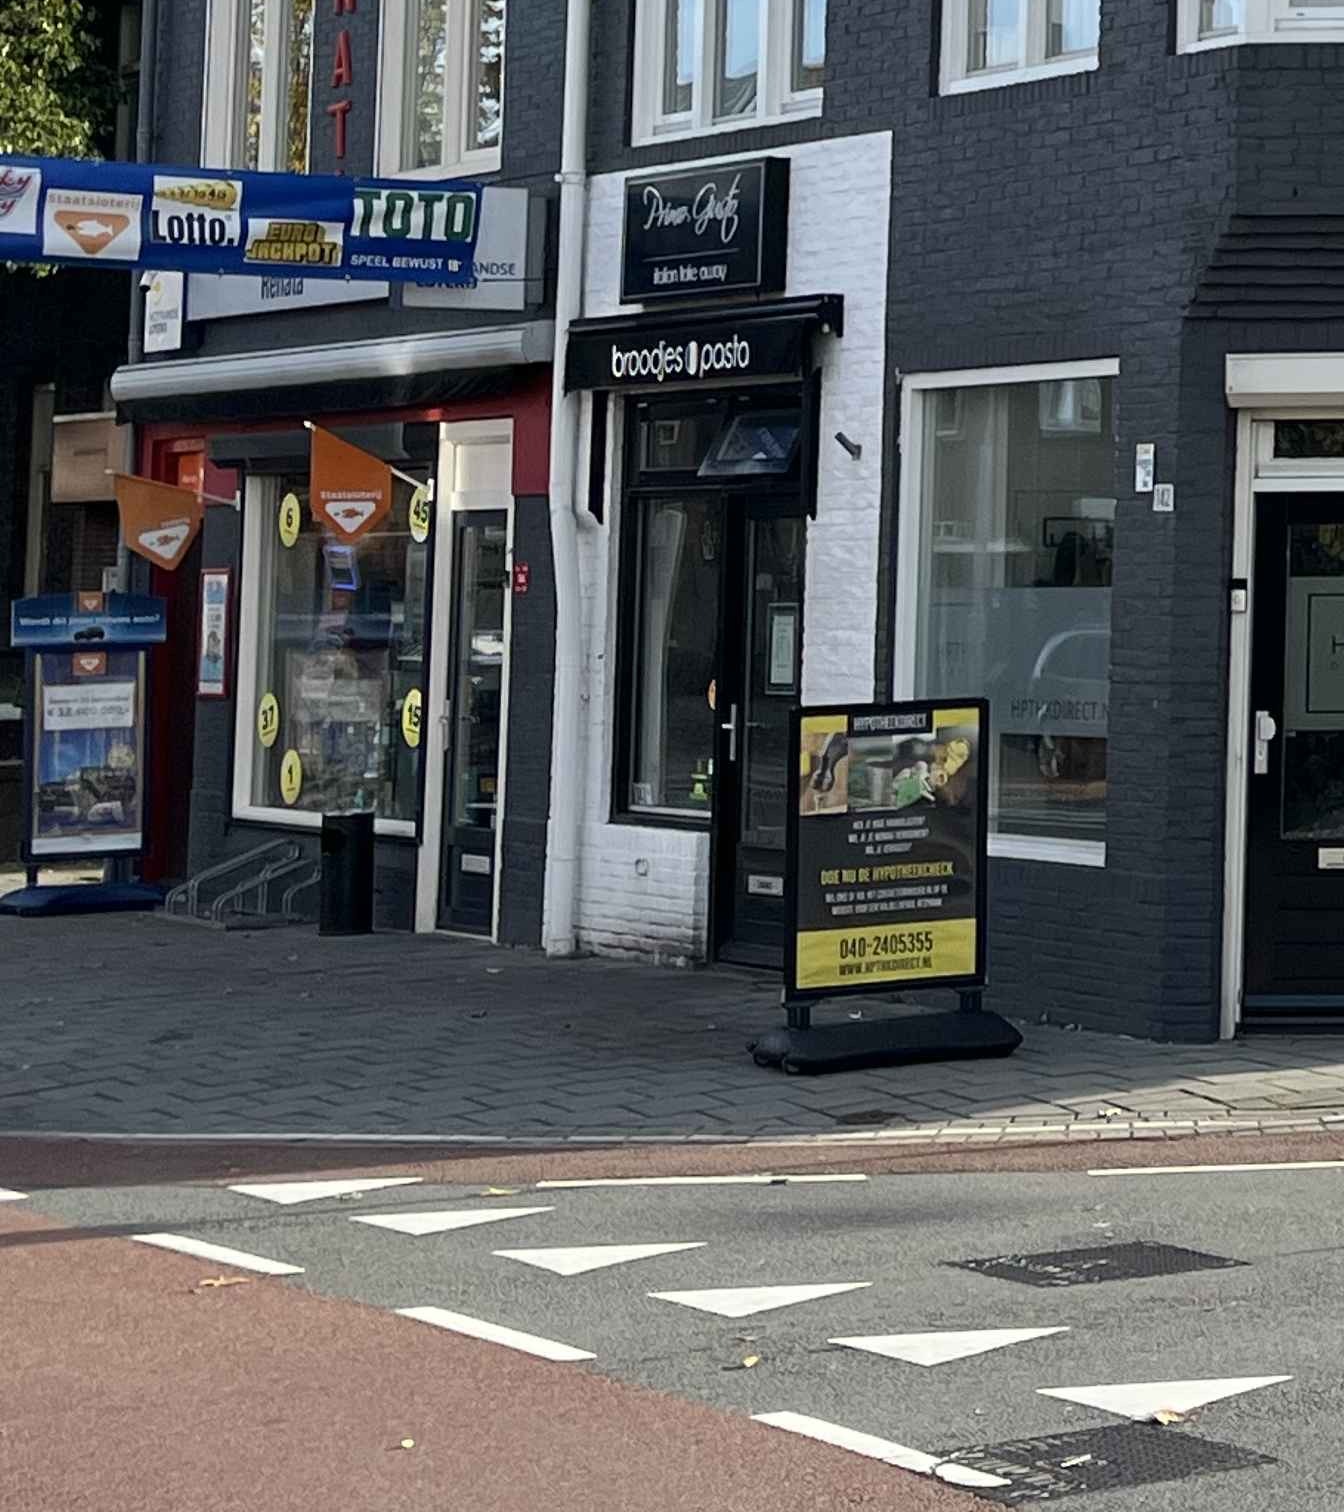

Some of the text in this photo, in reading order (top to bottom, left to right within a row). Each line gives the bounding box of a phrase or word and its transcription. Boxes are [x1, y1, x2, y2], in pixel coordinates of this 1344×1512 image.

[48, 192, 140, 209] Staatsloterij
[355, 191, 475, 242] TOTO
[245, 239, 342, 264] JACKPOT
[350, 255, 389, 268] SPEEL
[393, 257, 444, 270] BEWUST
[473, 262, 516, 276] ANDSE
[612, 340, 683, 382] broodjes
[700, 334, 750, 378] pasta
[412, 502, 429, 524] 45
[262, 705, 275, 724] 37
[407, 705, 421, 727] 15
[1010, 697, 1108, 721] HPTHKDIRECT.N
[839, 931, 933, 959] 040-2405355
